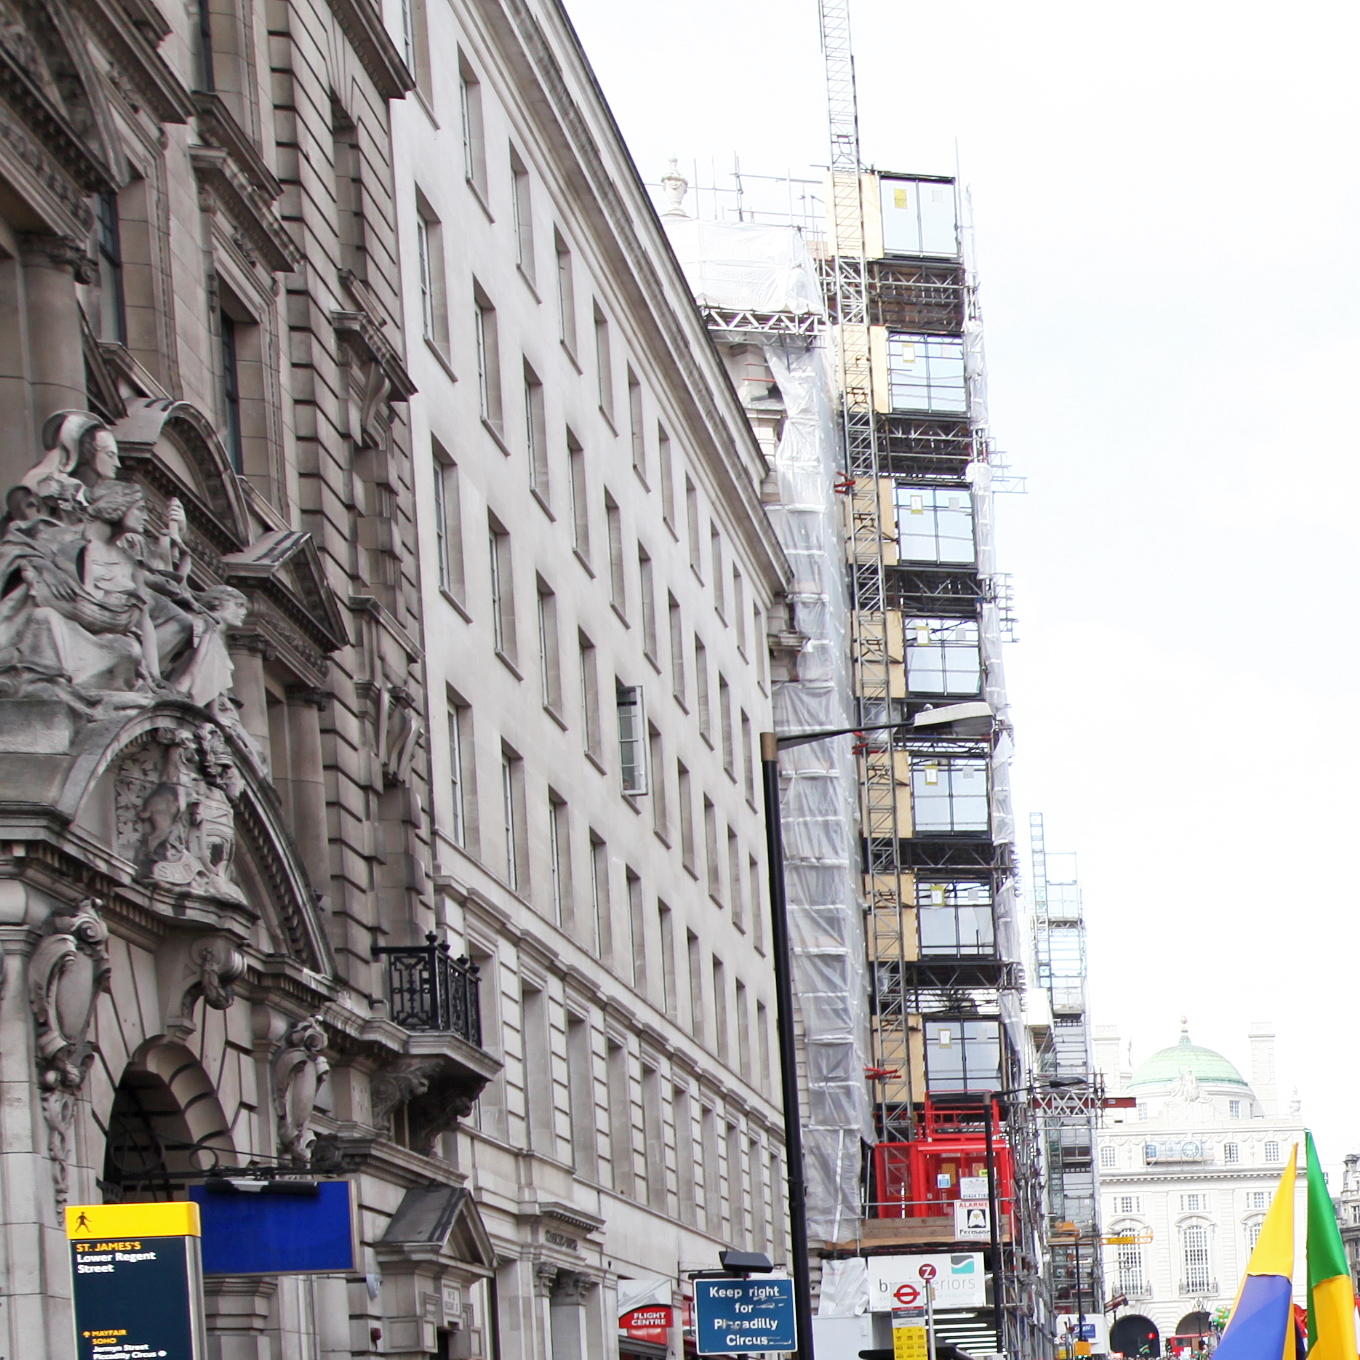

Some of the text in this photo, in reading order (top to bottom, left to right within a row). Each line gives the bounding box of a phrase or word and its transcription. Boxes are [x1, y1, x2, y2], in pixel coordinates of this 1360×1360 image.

[76, 1242, 142, 1252] ST. JAMES'S
[77, 1252, 157, 1263] Lower Regent
[78, 1264, 115, 1274] Street
[921, 1266, 933, 1279] Z
[709, 1286, 779, 1299] Keep right
[735, 1303, 754, 1313] for
[91, 1329, 127, 1337] MAYFAIR
[726, 1335, 768, 1346] Circus
[93, 1345, 122, 1353] Jermyn
[93, 1352, 130, 1360] Piccadilly
